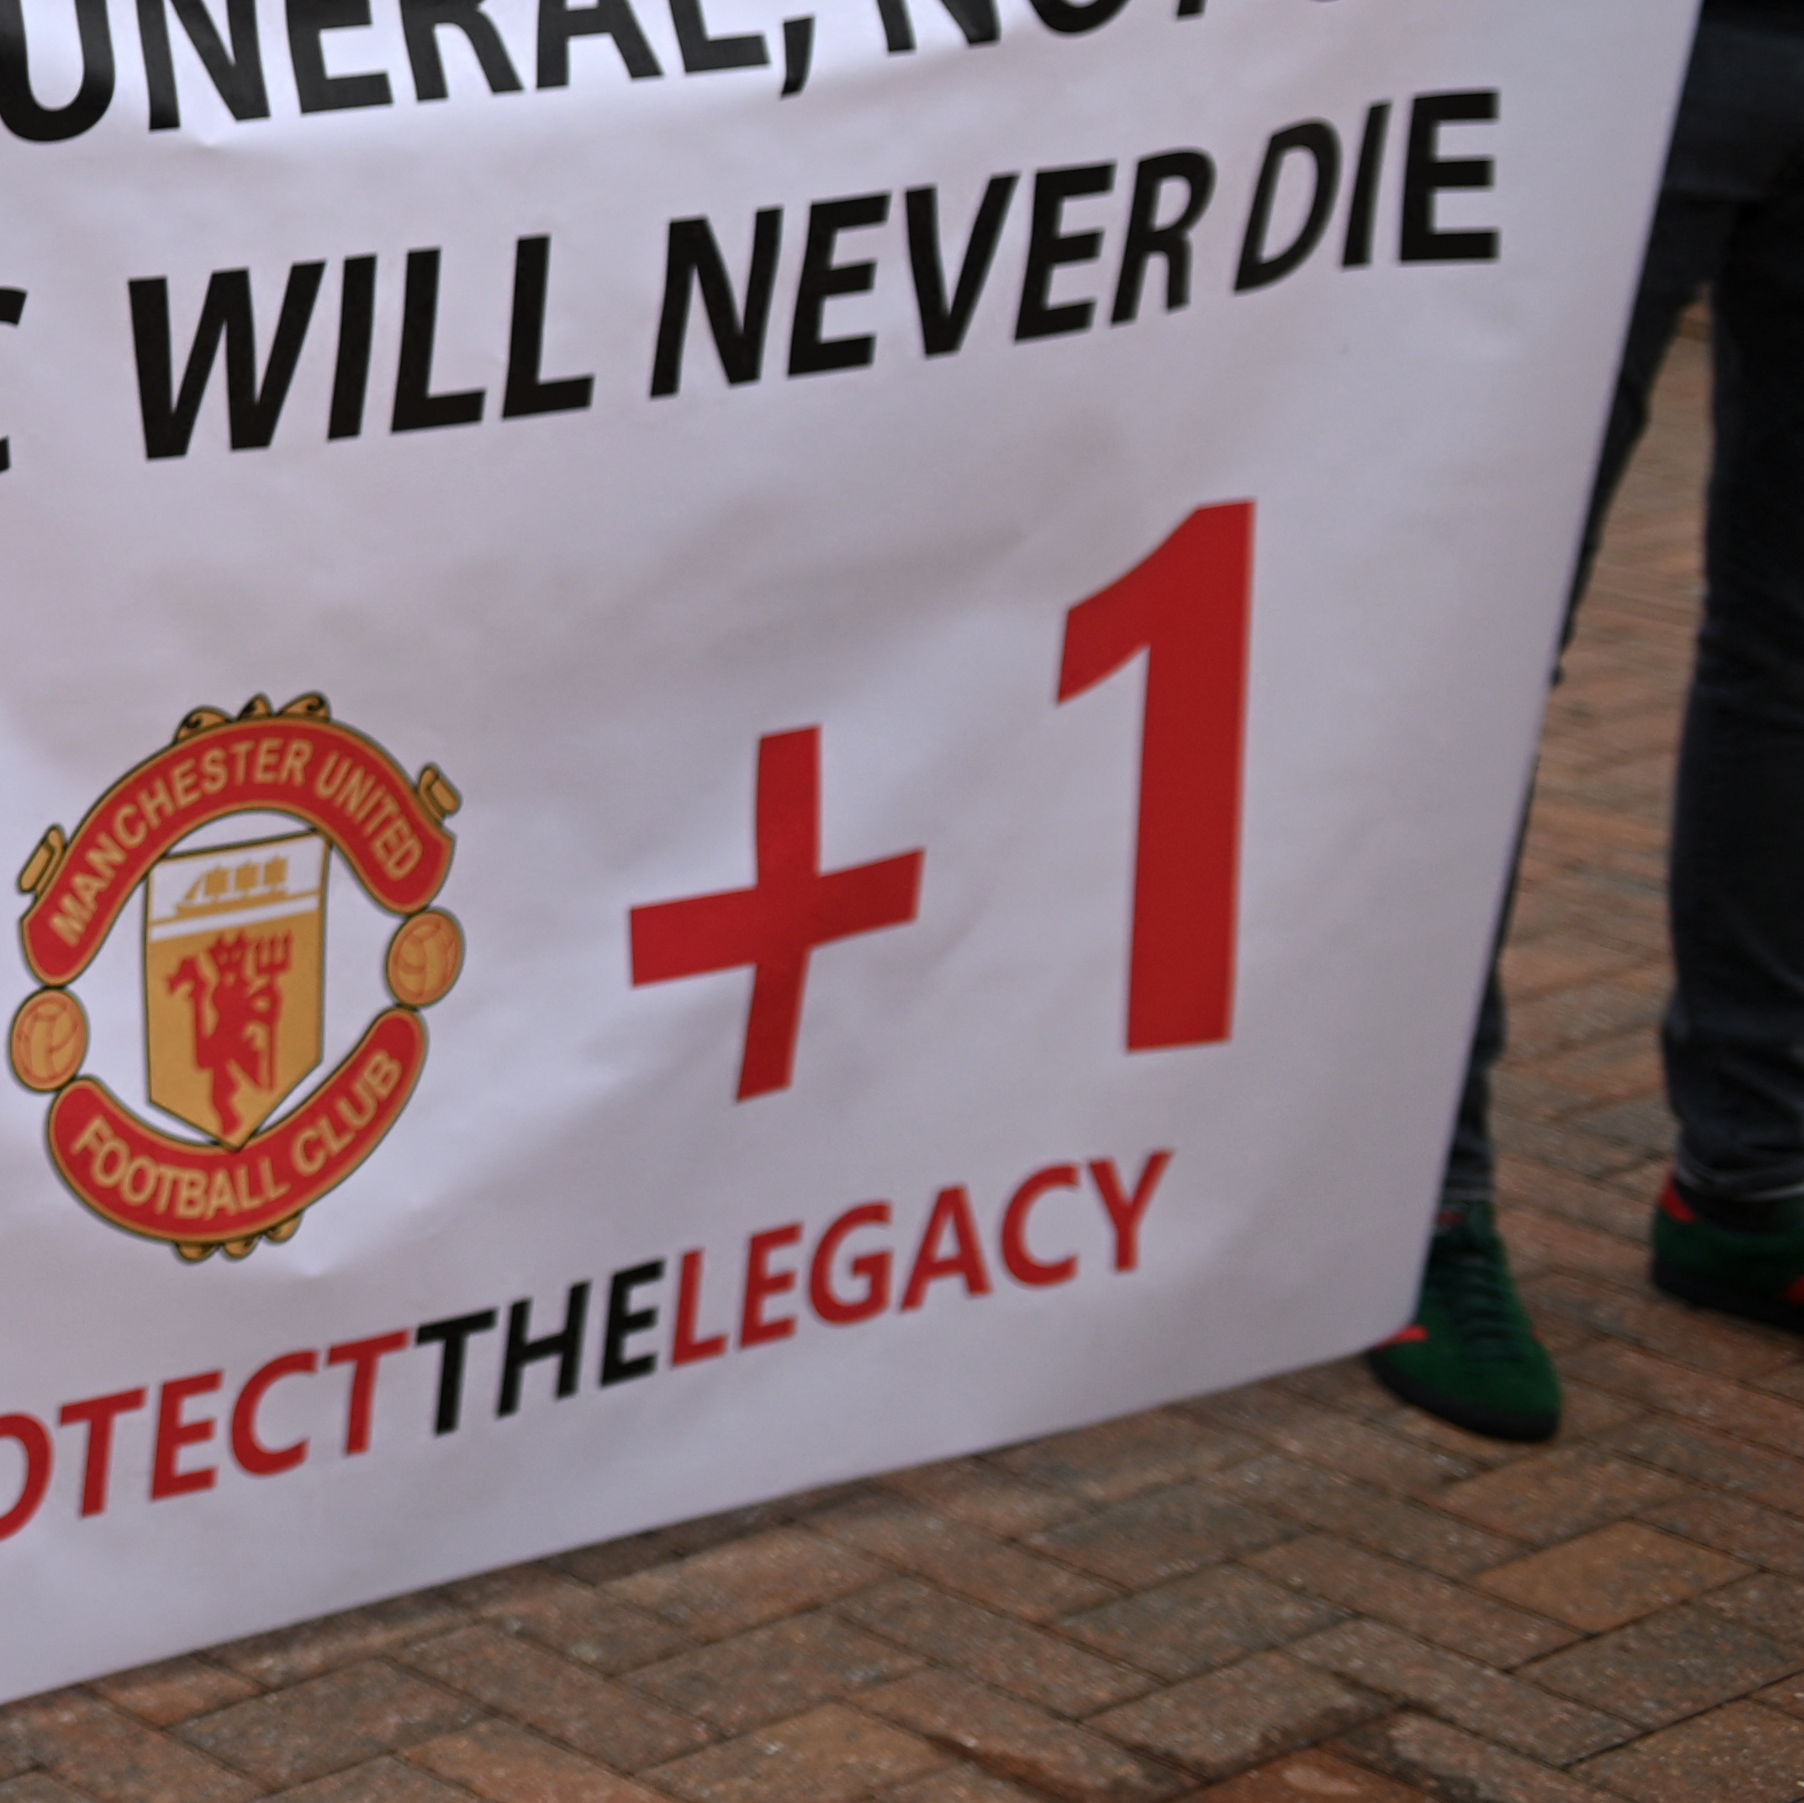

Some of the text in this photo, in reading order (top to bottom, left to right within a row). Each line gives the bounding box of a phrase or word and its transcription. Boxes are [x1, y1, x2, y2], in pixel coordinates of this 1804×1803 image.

[127, 235, 595, 461] WILL
[649, 149, 1216, 399] NEVER
[1232, 90, 1499, 293] DIE
[48, 736, 424, 949] MANCHESTER UNITED
[69, 1046, 404, 1221] FOOTBALL CLUB
